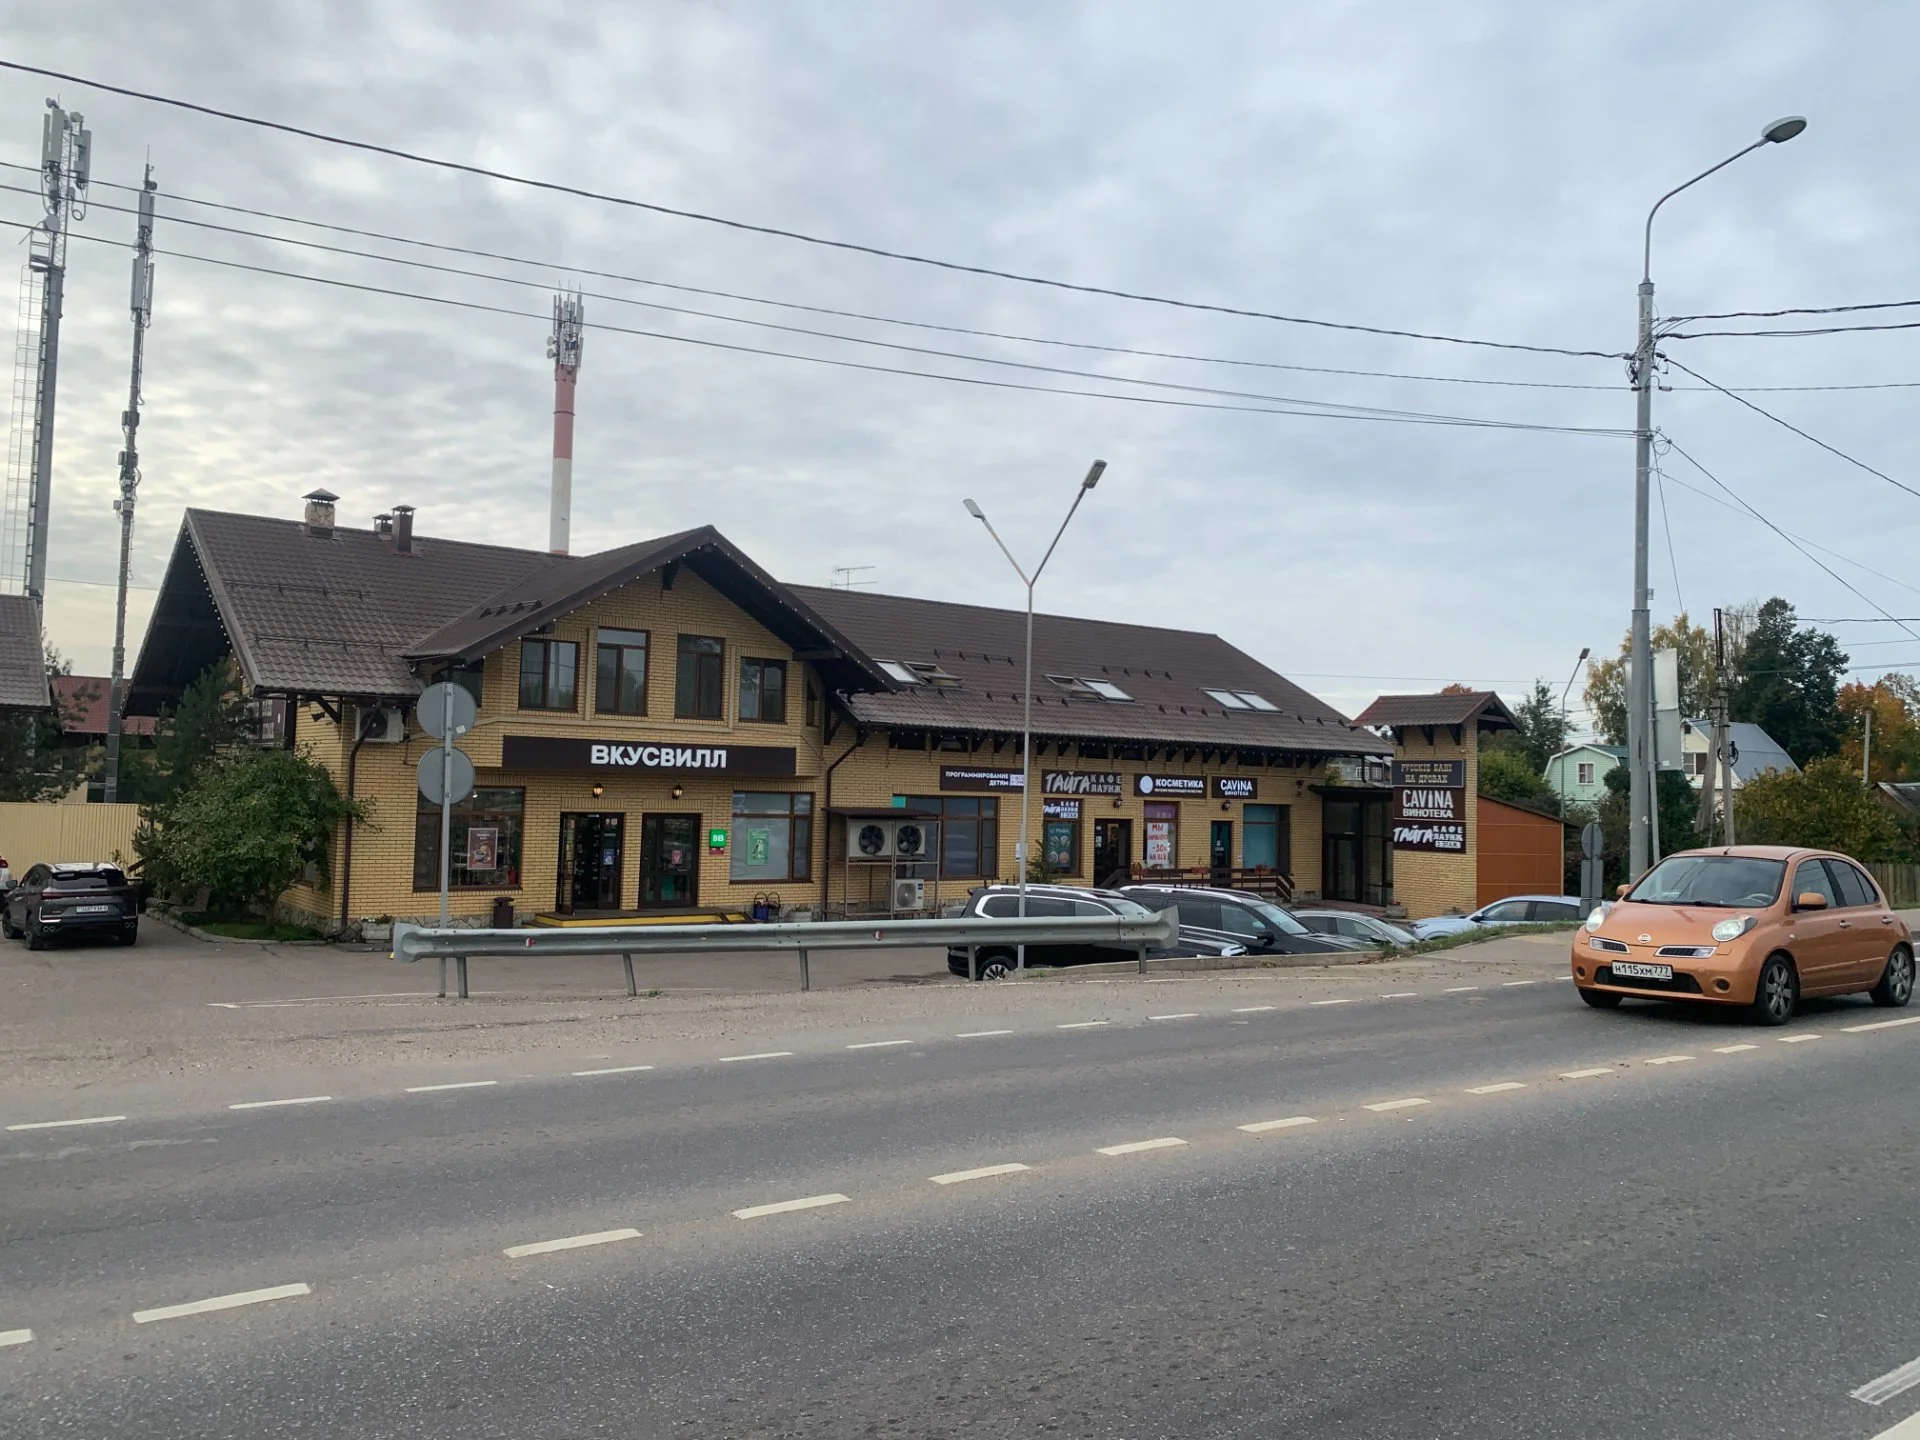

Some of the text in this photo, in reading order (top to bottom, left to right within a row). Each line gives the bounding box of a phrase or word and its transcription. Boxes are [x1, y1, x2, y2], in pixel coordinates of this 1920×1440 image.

[590, 745, 727, 768] ВКУСВИЛЛ
[945, 771, 1009, 779] ПРОГРАММИРОВАНИЕ
[1090, 774, 1122, 784] КАФЕ
[1045, 771, 1091, 794] ТАЙГА
[1155, 779, 1204, 789] КОСМЕТИКА
[1220, 779, 1253, 791] CAVINA
[1091, 784, 1122, 793] ЛАУНЖ
[1402, 789, 1454, 808] CAVINA
[1402, 808, 1454, 818] ВИНОТЕКА
[1432, 825, 1464, 833] КАФЕ
[1393, 825, 1433, 844] ТАЙГА
[1433, 833, 1464, 842] ЛАУНЖ
[1653, 966, 1669, 974] 777
